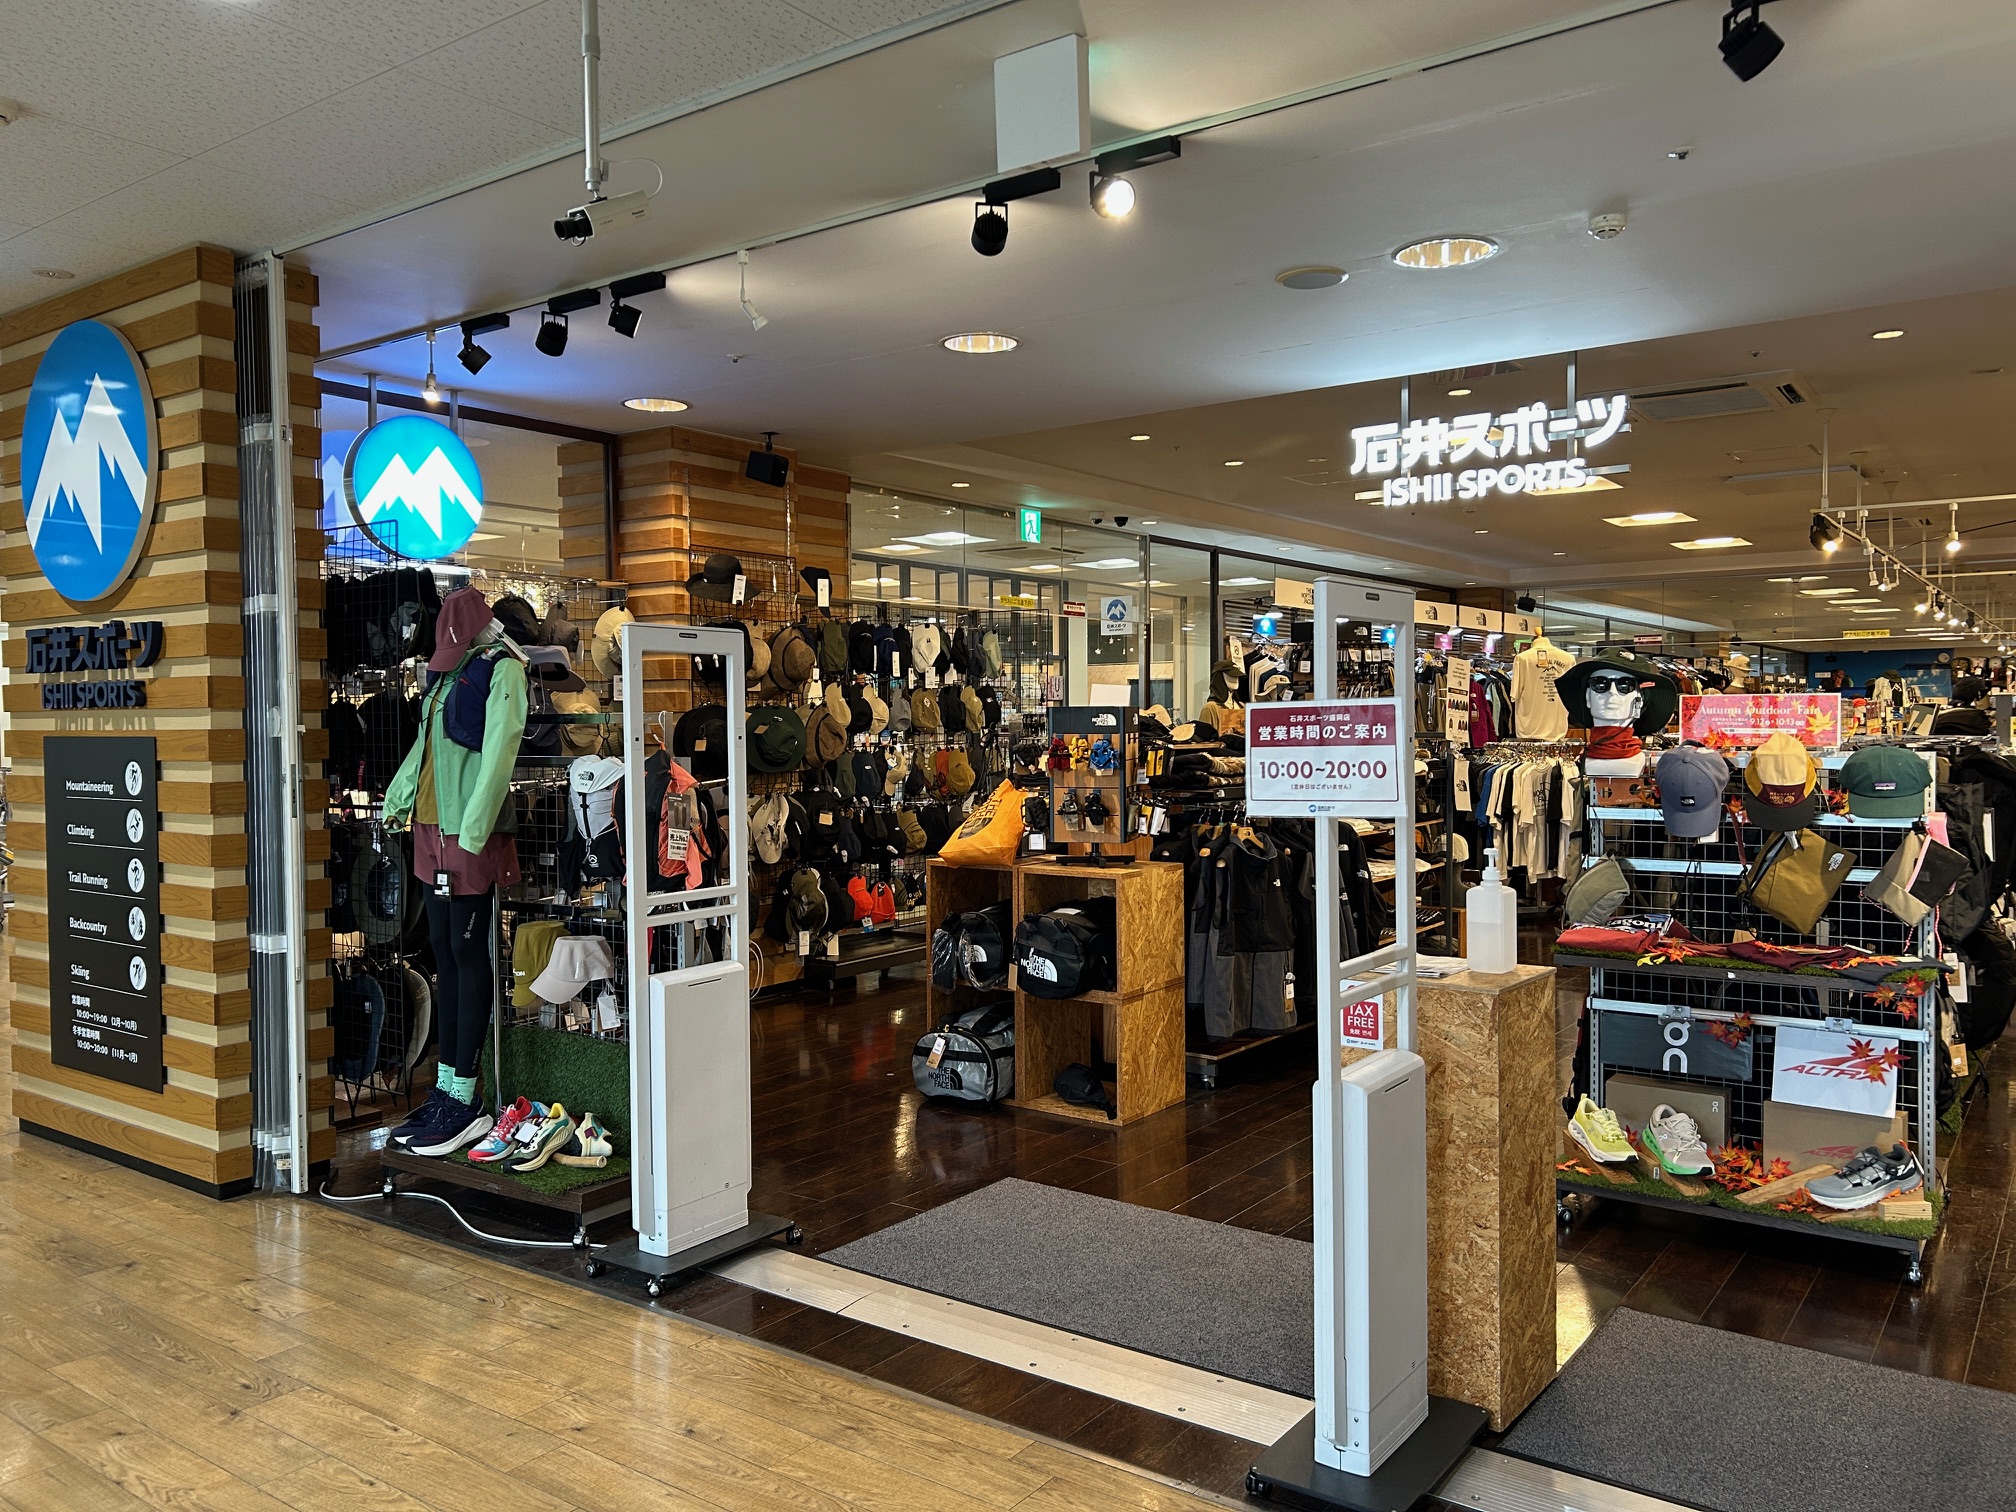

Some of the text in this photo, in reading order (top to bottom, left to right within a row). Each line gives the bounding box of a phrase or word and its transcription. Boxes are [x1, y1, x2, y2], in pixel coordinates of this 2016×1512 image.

[1350, 394, 1627, 475] 石井スポーツ
[1383, 457, 1588, 507] ISHII SPORTS
[25, 619, 162, 673] 石井スポーツ
[41, 680, 138, 709] ISHII SPORTS
[1701, 704, 1820, 715] Autumn Outdoor Fair
[1258, 723, 1387, 741] 営業時間のご案内
[1259, 760, 1387, 779] 10:00~20:00
[65, 780, 114, 795] Mountaineering
[67, 824, 95, 839] Climbing
[68, 871, 109, 889] Trail Running
[69, 917, 108, 936] Backcountry
[1033, 954, 1046, 964] THE
[70, 964, 90, 981] Skiing
[1350, 1003, 1374, 1018] TAX
[1347, 1015, 1375, 1029] FREE
[928, 1071, 949, 1082] NORTH
[934, 1080, 950, 1090] FACE
